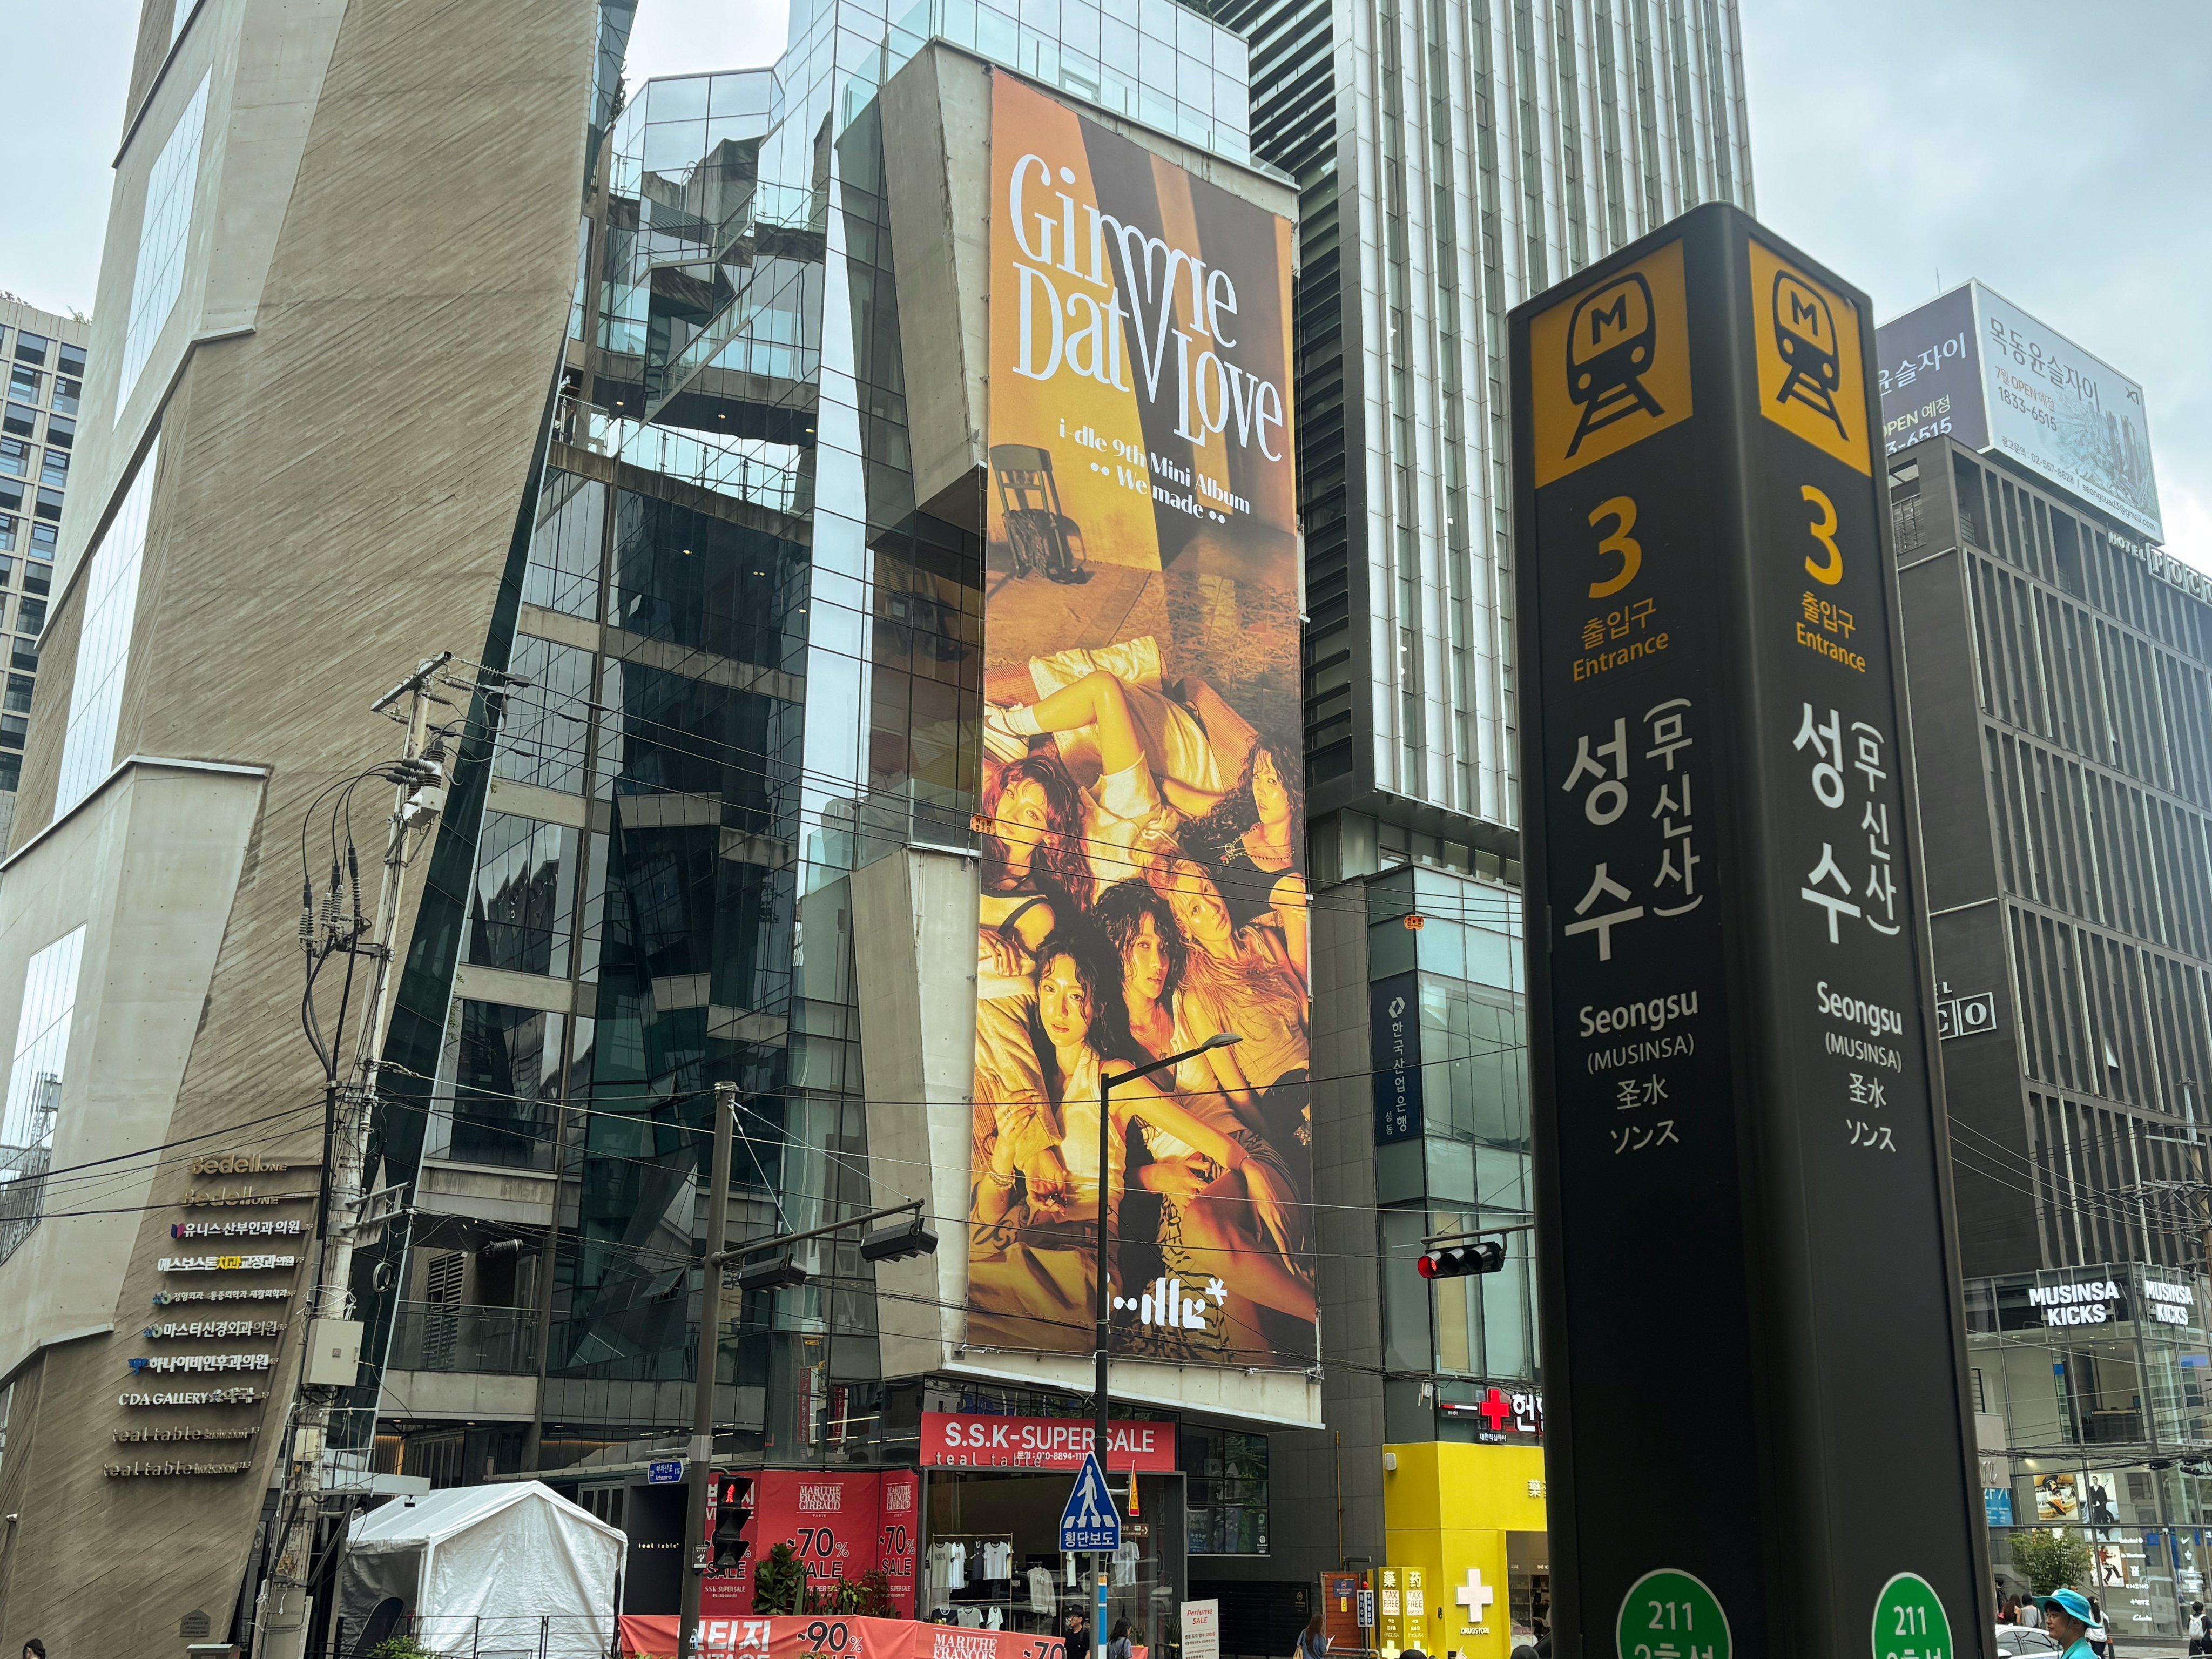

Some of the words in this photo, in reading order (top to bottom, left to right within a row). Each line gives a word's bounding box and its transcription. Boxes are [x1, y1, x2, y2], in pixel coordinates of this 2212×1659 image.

[1013, 261, 1130, 392] Dat
[1171, 327, 1283, 462] Love
[1990, 317, 2100, 413] 목동윤슬자이
[1995, 366, 2010, 386] 7월
[2011, 376, 2037, 401] OPEN
[2038, 392, 2055, 412] 예정
[1921, 394, 1951, 418] 예정
[1998, 386, 2057, 432] 1833-6515
[1112, 439, 1147, 468] 9th
[1150, 451, 1191, 488] Mini
[1195, 473, 1250, 515] Album
[1116, 464, 1148, 495] We
[1152, 484, 1204, 519] made
[2001, 435, 2026, 459] 광고문의
[2031, 453, 2074, 484] 02-557-8828
[2082, 484, 2155, 532] seongsuad3@gmail.com
[1588, 496, 1642, 599] 3
[1800, 485, 1843, 585] 3
[2108, 531, 2146, 562] HOTEL
[1581, 597, 1657, 650] 출입구
[1800, 591, 1856, 640] 출입구
[1573, 630, 1669, 683] Entrance
[1796, 621, 1866, 673] Entrance
[1792, 702, 1861, 945] 성수
[1561, 717, 1644, 962] 성수
[1579, 990, 1699, 1038] Seongsu
[1817, 981, 1903, 1036] Seongsu
[1587, 1033, 1695, 1076] (MUSINSA)
[1825, 1031, 1902, 1074] (MUSINSA)
[1391, 1020, 1407, 1132] 한국산업은행
[1849, 1072, 1887, 1109] 圣水
[1616, 1073, 1669, 1111] 圣水
[1385, 1110, 1393, 1136] 성동
[1610, 1119, 1680, 1154] ソンス
[1846, 1118, 1897, 1153] ソンス
[2029, 1281, 2120, 1307] MUSINSA
[2145, 1280, 2194, 1305] MUSINSA
[2047, 1304, 2107, 1326] KICKS
[2156, 1303, 2188, 1325] KICKS
[149, 1354, 269, 1373] 하나이비인후과의원
[118, 1393, 150, 1406] CDA
[153, 1392, 209, 1405] GALLERY
[156, 1426, 201, 1442] table
[1479, 1432, 1507, 1442] 대한적십자사
[144, 1460, 192, 1476] table
[936, 1452, 977, 1466] teal
[990, 1452, 1042, 1467] table
[800, 1485, 841, 1495] MARITHÉ
[799, 1501, 841, 1510] GIRBAUD
[886, 1501, 911, 1510] GIRBAUD
[1064, 1531, 1115, 1548] 횡단보도
[805, 1560, 844, 1579] ALE
[881, 1557, 912, 1576] SALE
[1383, 1570, 1397, 1588] 藥
[1409, 1571, 1421, 1588] 药
[1384, 1599, 1399, 1608] FREE
[1385, 1590, 1397, 1599] TAX
[1407, 1600, 1423, 1608] FREE
[1187, 1608, 1213, 1616] Perfume
[1648, 1600, 1693, 1631] 211
[1893, 1606, 1927, 1635] 211
[934, 1633, 997, 1651] MARITHÉ
[1460, 1627, 1491, 1635] DRUGSTORE
